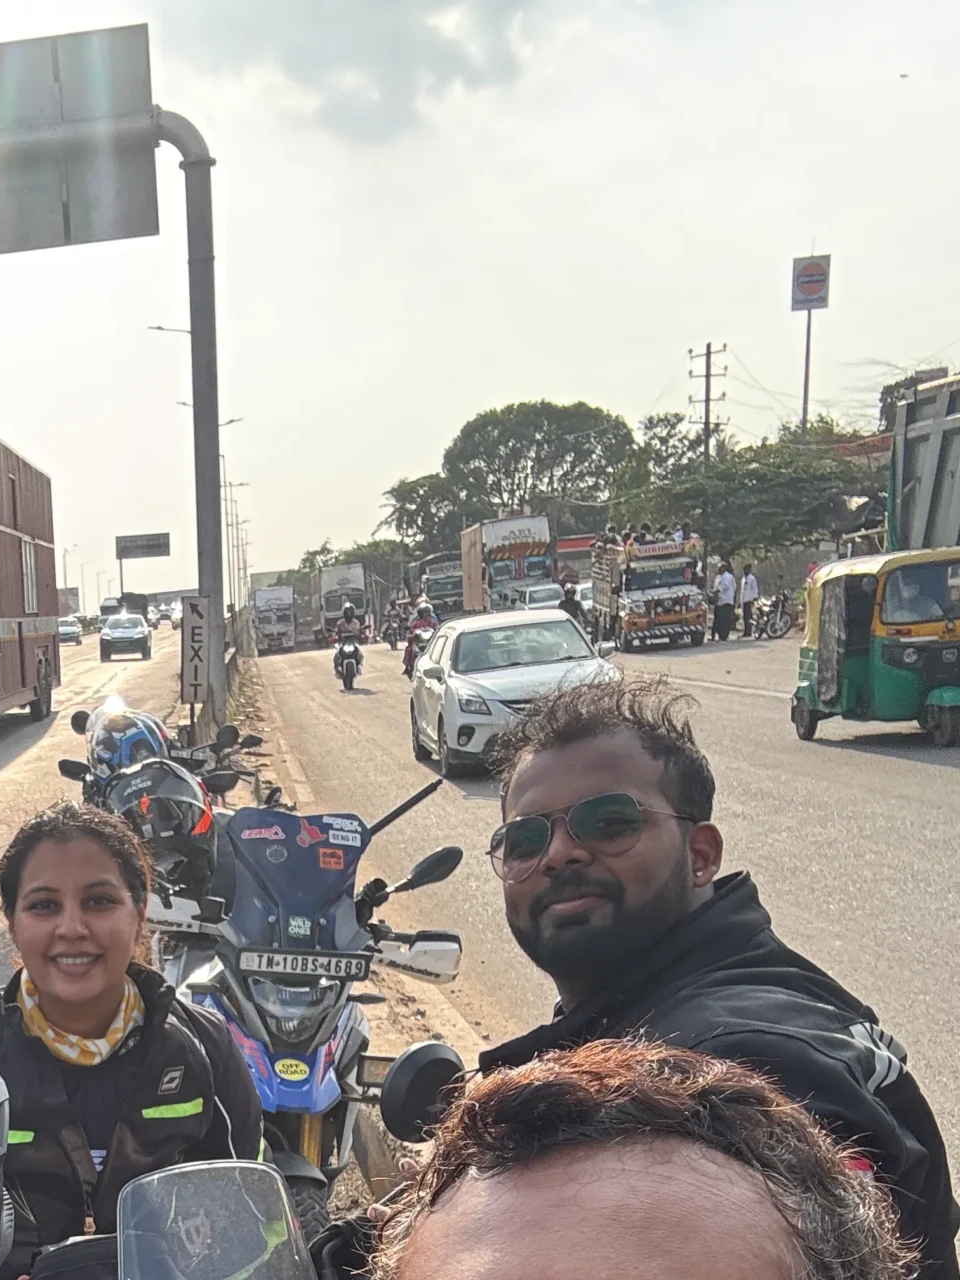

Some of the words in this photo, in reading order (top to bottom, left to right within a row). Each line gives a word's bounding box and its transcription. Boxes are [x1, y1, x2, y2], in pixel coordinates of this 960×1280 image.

[189, 625, 204, 701] EXIT
[351, 834, 359, 844] IT
[289, 918, 312, 928] WILD
[288, 926, 311, 935] ONES
[281, 1062, 301, 1070] OFF
[278, 1068, 308, 1077] ROAD
